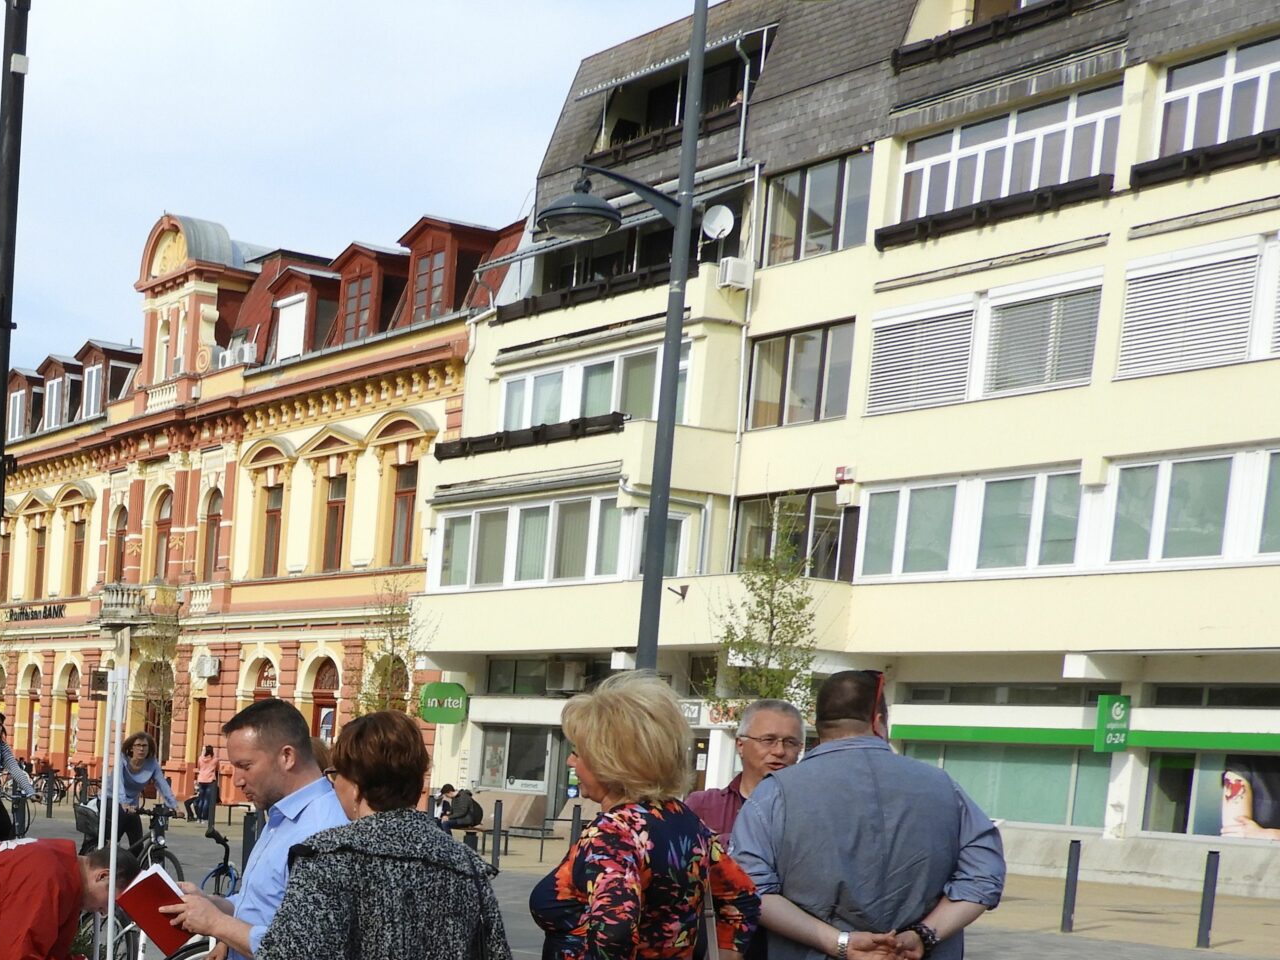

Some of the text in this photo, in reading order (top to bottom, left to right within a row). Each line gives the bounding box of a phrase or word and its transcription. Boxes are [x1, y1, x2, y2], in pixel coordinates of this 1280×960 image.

[43, 604, 67, 619] BANK
[427, 697, 462, 709] invitel
[1106, 732, 1126, 744] 0-24
